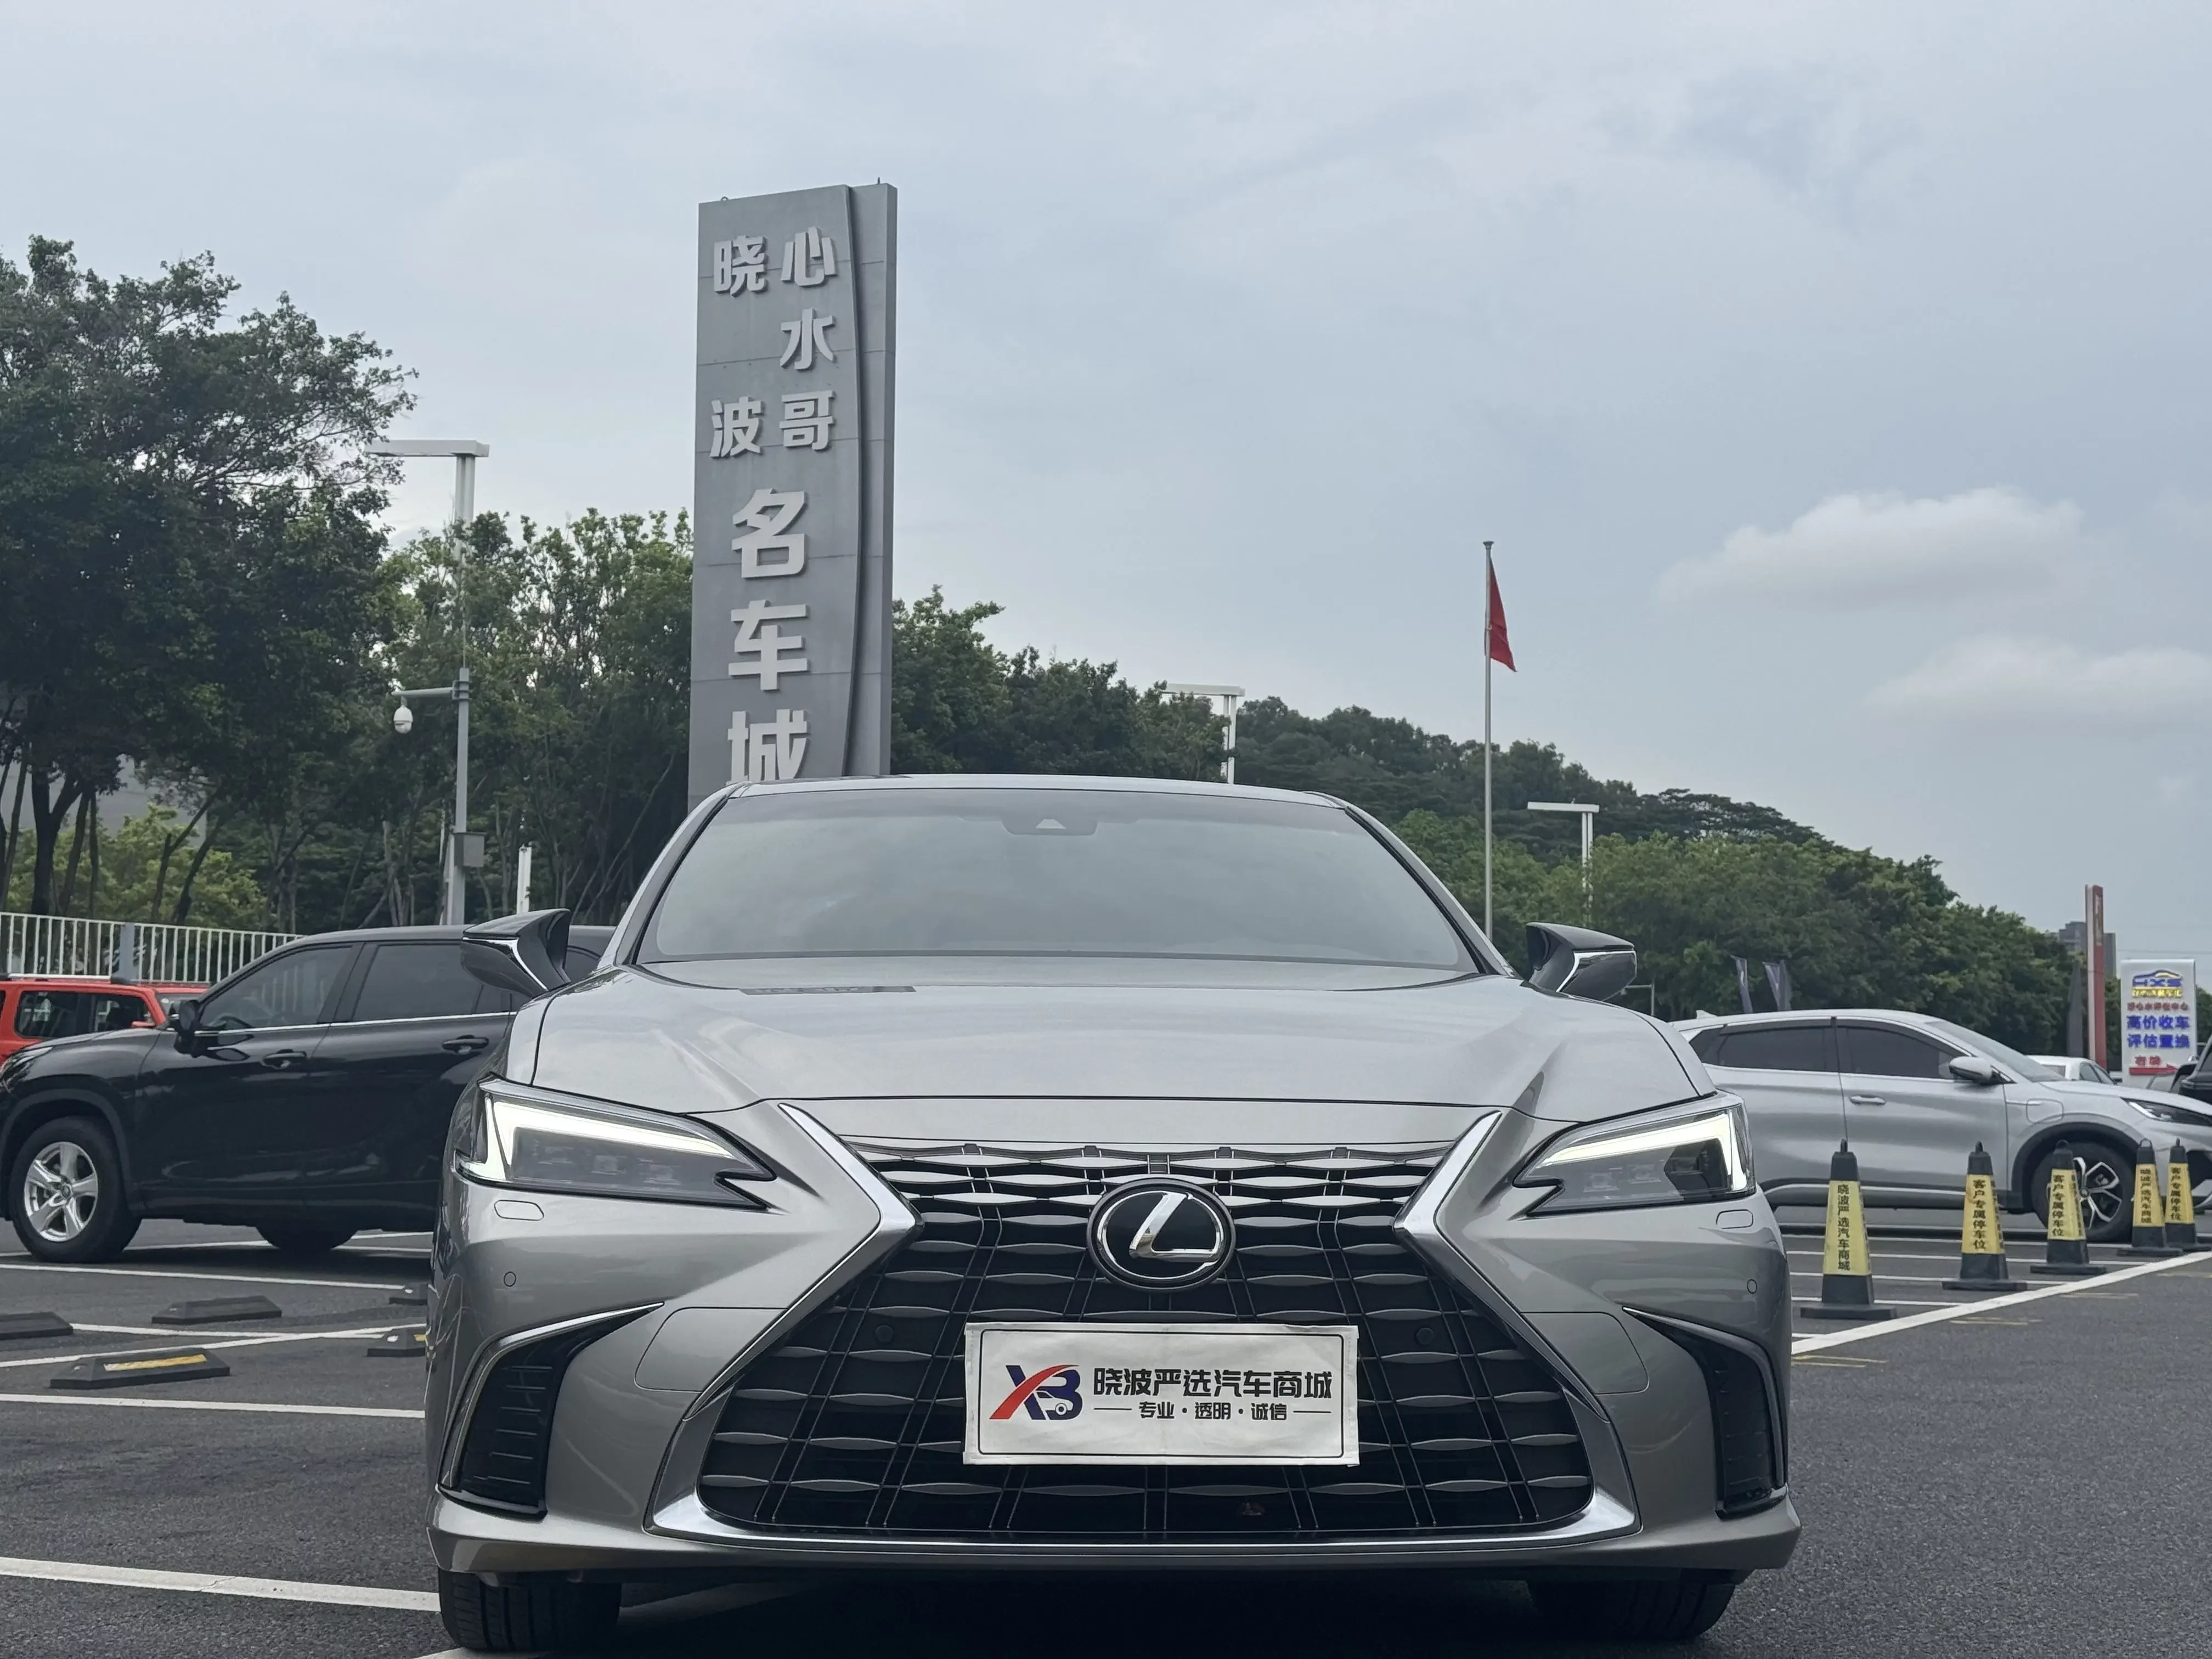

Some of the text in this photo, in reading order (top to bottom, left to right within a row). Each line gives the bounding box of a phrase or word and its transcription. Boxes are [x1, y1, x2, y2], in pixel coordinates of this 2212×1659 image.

[709, 235, 766, 459] 晓波
[779, 226, 836, 451] 心水哥
[726, 487, 809, 785] 名车城
[2127, 1015, 2190, 1030] 高价收车
[2127, 1033, 2190, 1049] 评估置换
[1972, 1179, 1986, 1249] 客户专属停车位
[2051, 1175, 2064, 1236] 客户专属停车位
[2170, 1167, 2182, 1221] 客户专属停车位
[1837, 1184, 1851, 1271] 晓波严选汽车商城
[1093, 1367, 1332, 1398] 晓波严选汽车商城
